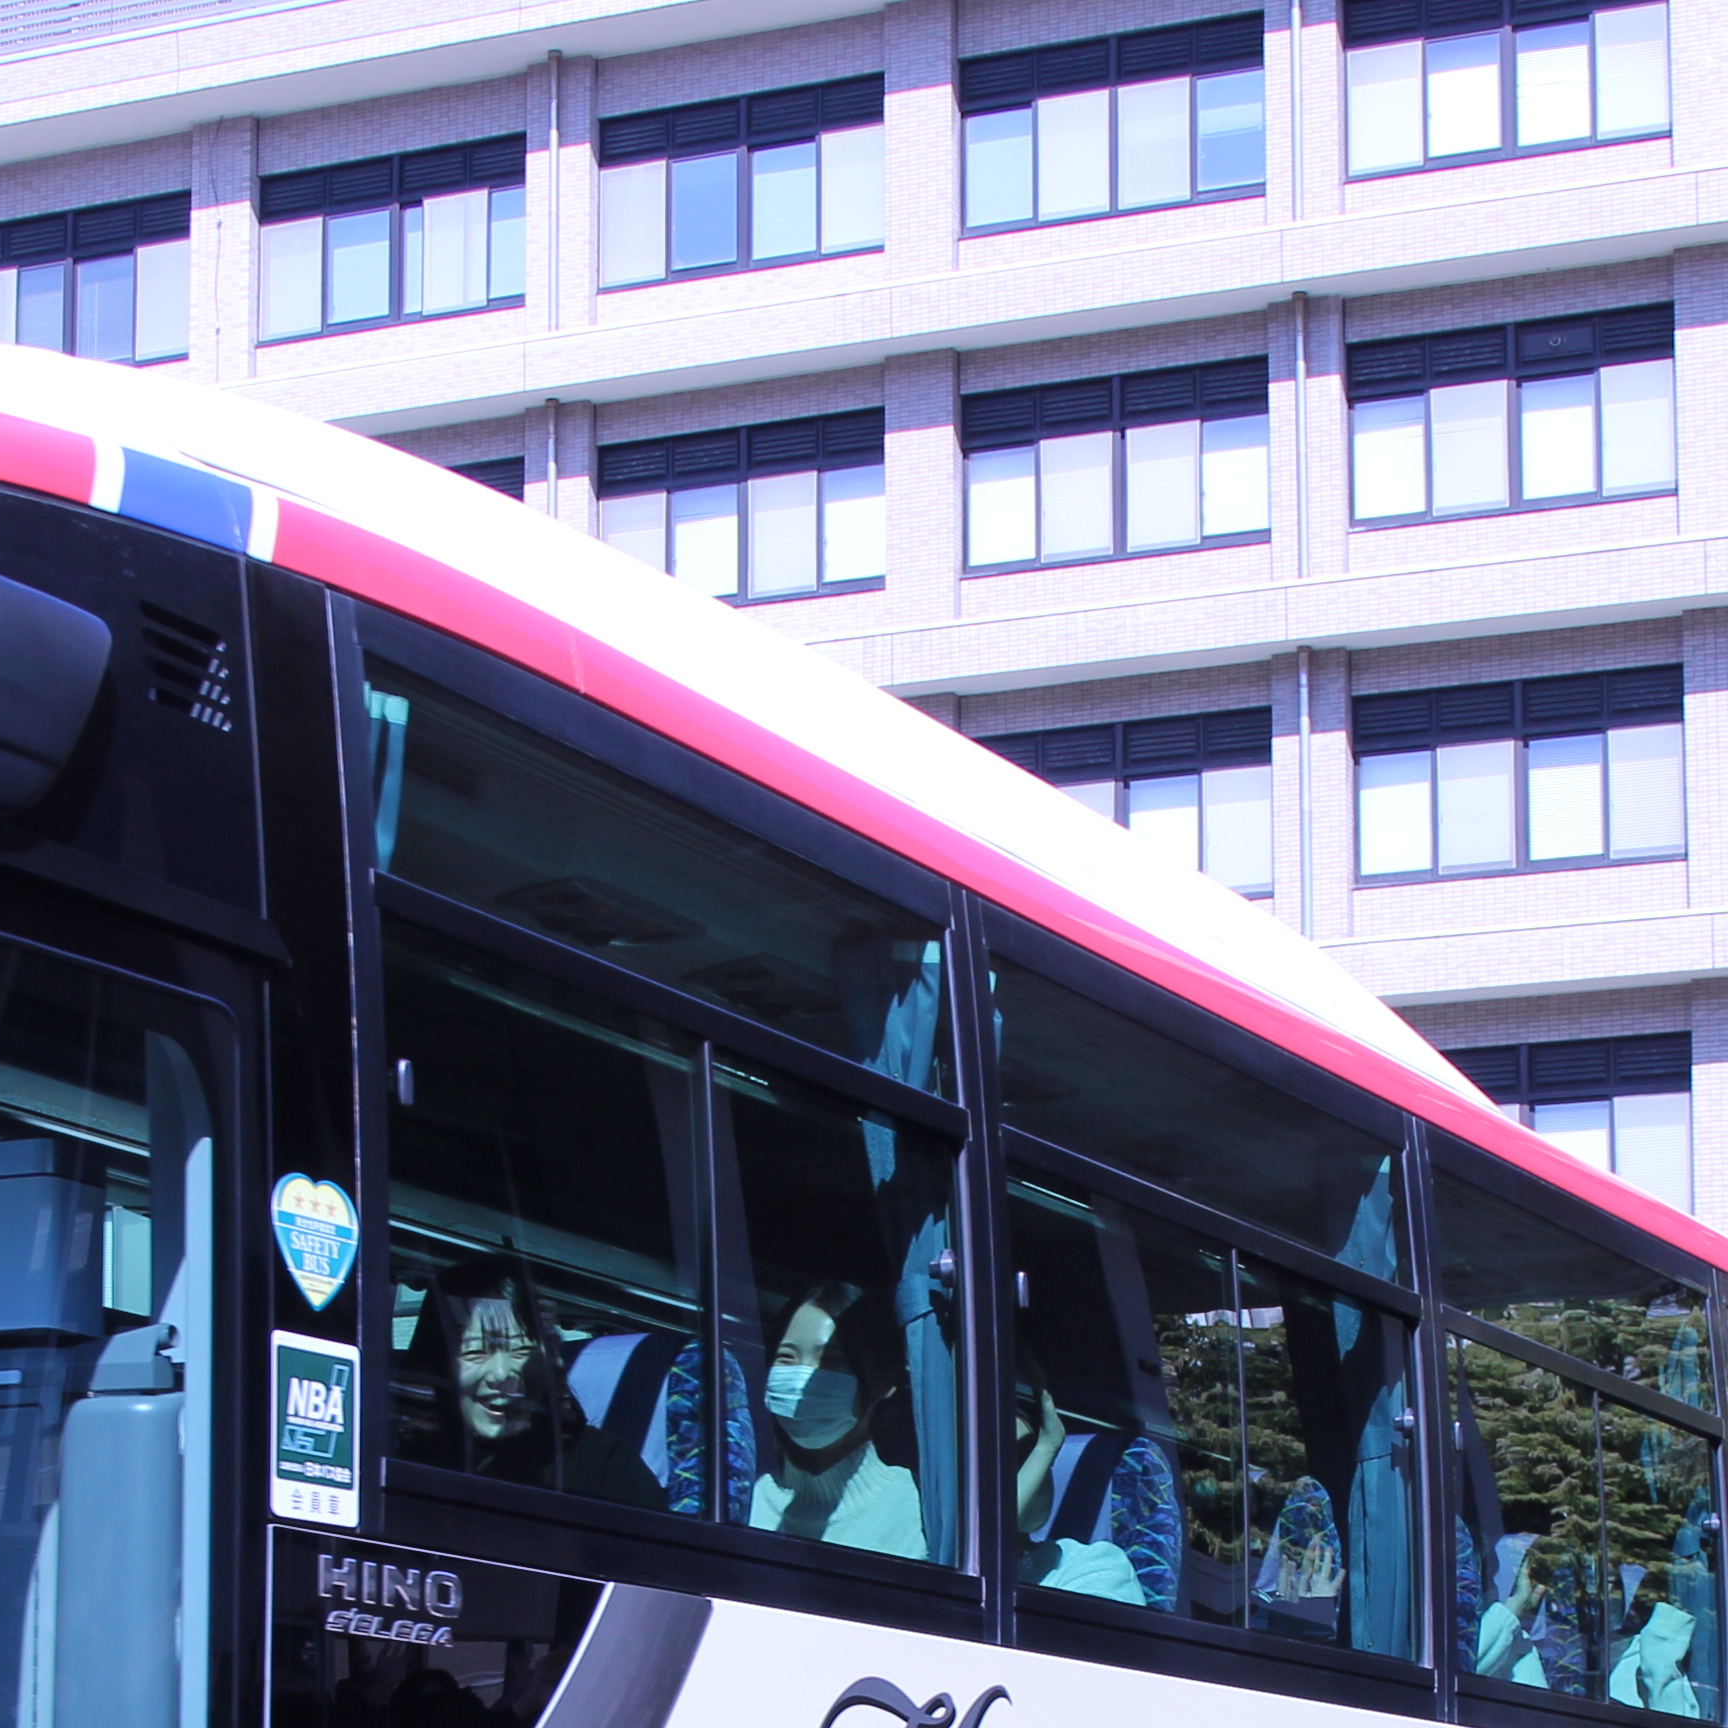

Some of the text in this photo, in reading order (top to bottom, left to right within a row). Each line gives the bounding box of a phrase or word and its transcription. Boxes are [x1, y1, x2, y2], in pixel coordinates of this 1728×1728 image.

[289, 1231, 341, 1260] SAFETY
[302, 1251, 332, 1275] BUS
[286, 1377, 344, 1425] NBA
[317, 1553, 464, 1619] HINO
[325, 1607, 454, 1649] SELEGA
